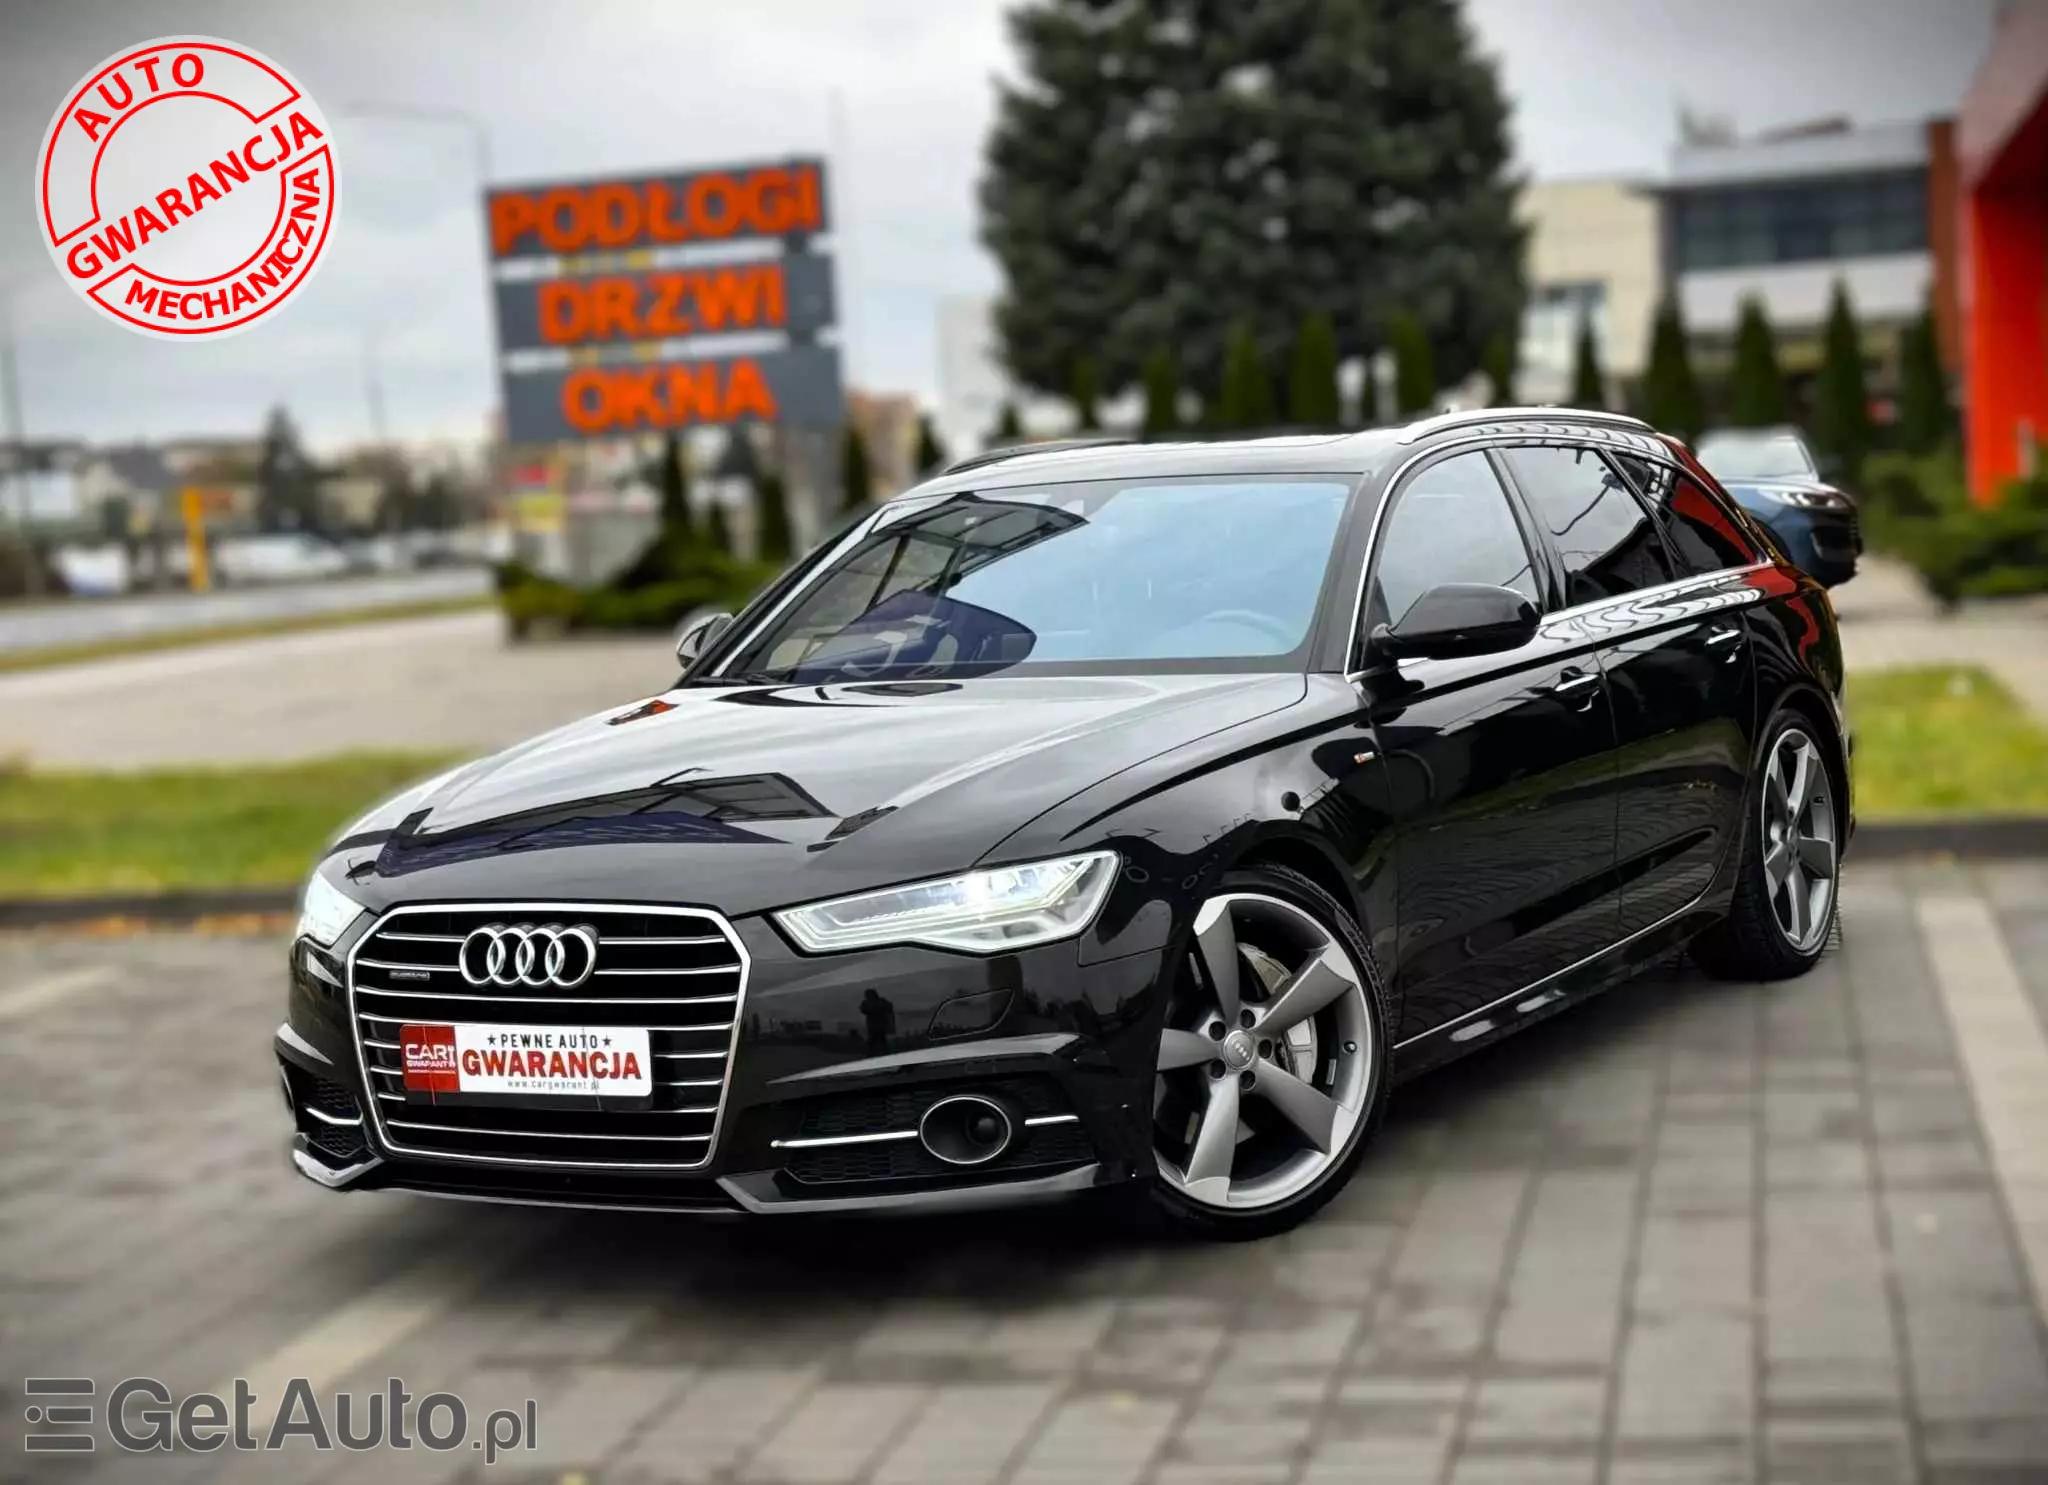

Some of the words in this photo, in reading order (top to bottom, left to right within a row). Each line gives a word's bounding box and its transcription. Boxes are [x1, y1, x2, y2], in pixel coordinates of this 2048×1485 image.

[537, 263, 785, 343] DRZWI
[561, 356, 778, 432] OKNA
[462, 1049, 642, 1080] GWARANCJA
[500, 1033, 553, 1048] PEWNE
[559, 1034, 598, 1049] AUTO
